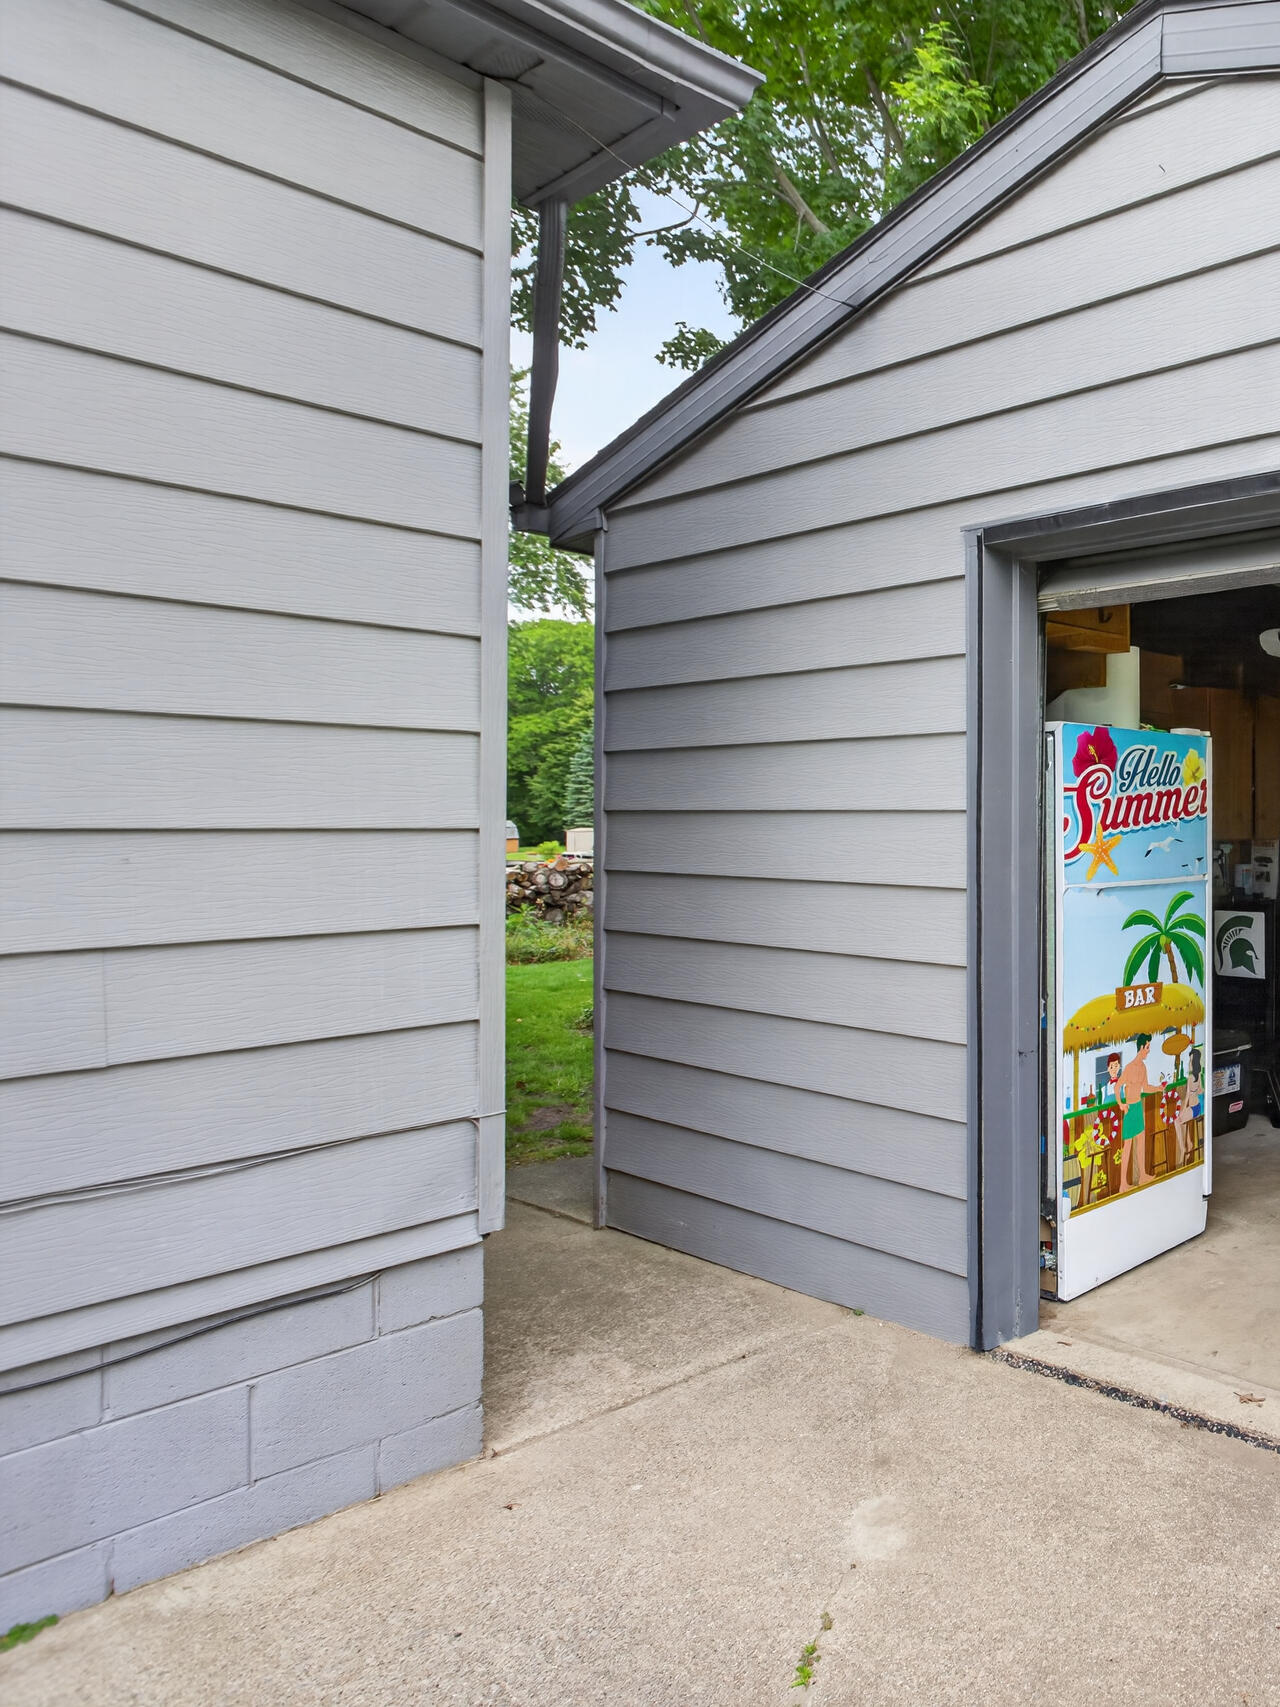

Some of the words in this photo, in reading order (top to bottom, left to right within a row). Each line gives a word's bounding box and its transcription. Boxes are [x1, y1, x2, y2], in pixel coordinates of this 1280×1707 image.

[1119, 748, 1181, 793] Hello
[1063, 768, 1208, 860] Summer
[1124, 986, 1156, 1009] BAR
